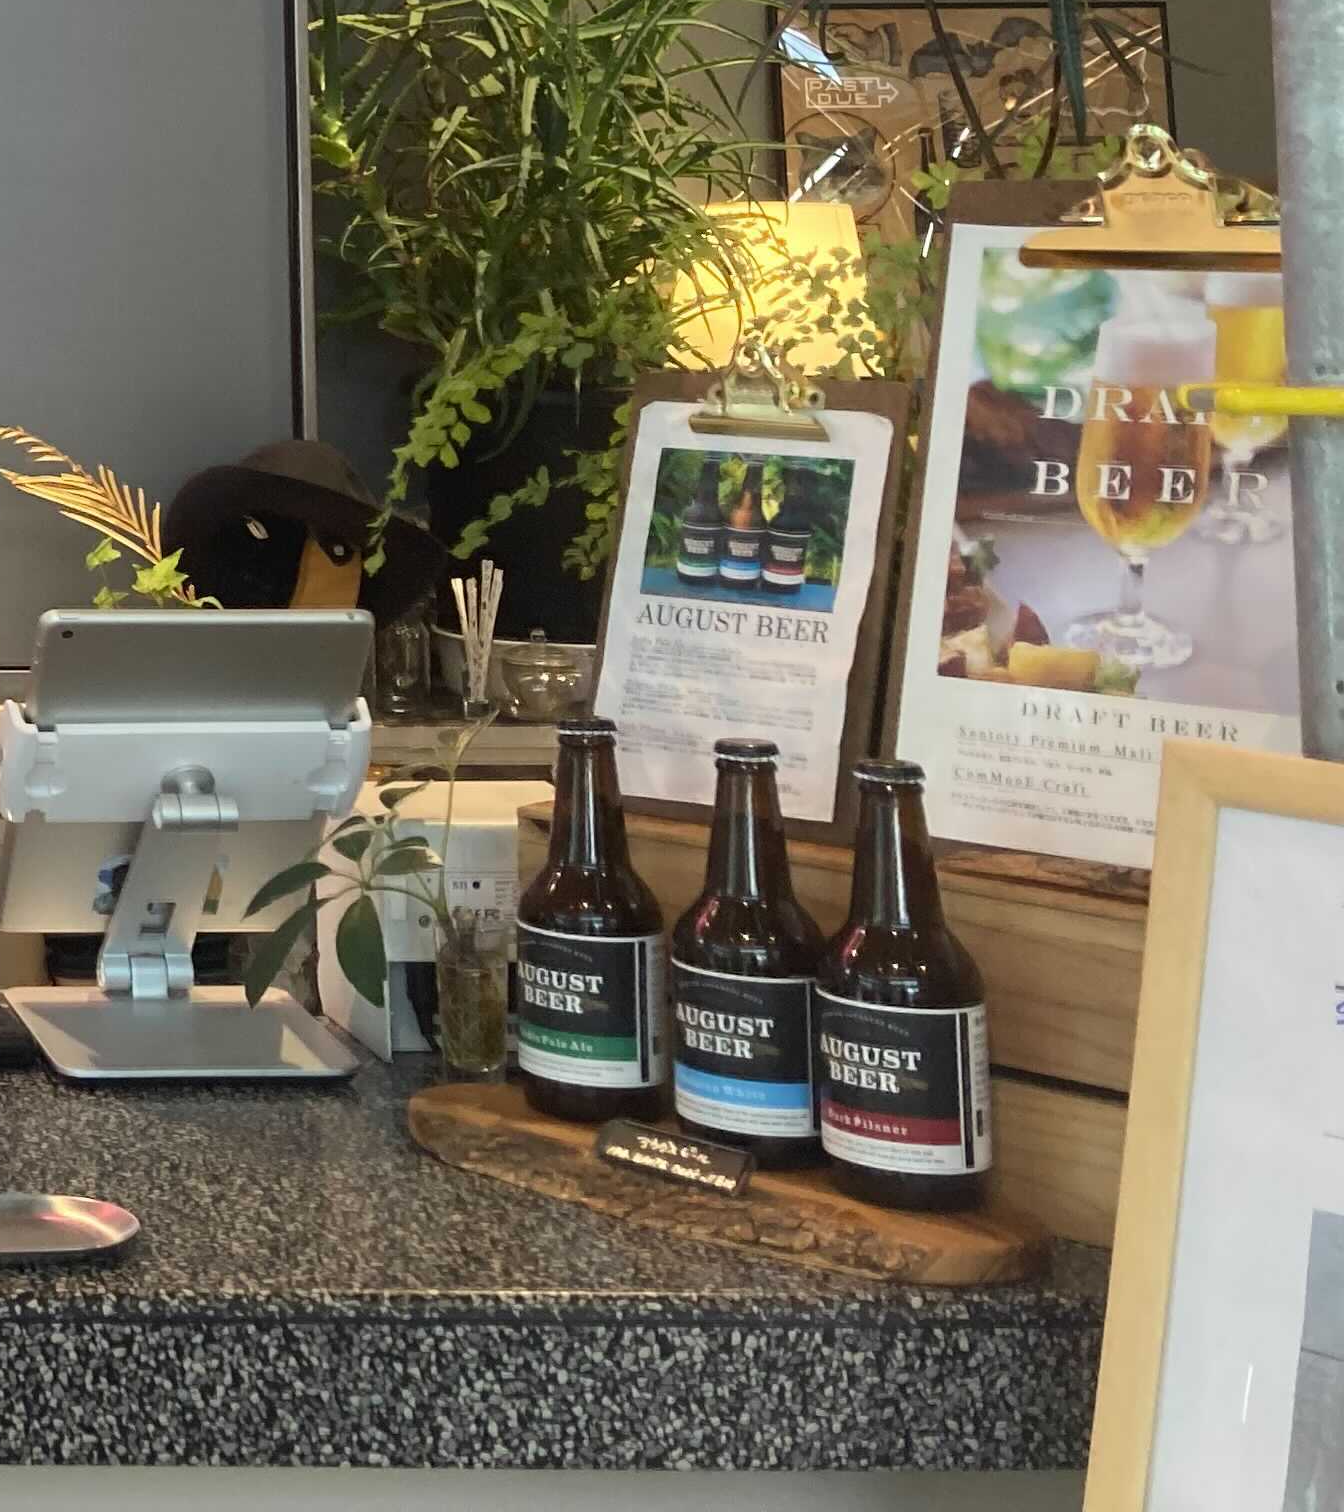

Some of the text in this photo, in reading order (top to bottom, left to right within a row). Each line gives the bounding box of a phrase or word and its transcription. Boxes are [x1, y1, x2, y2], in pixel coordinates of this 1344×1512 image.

[809, 80, 873, 92] PAST
[817, 93, 868, 104] DUE
[1030, 460, 1268, 508] BEER
[635, 602, 829, 645] AUGUST BEER
[1022, 701, 1238, 742] DRAFT BEER
[518, 959, 603, 994] AUGUST
[525, 984, 584, 1014] BEER
[676, 1002, 774, 1038] AUGUST
[685, 1028, 753, 1059] BEER
[821, 1033, 921, 1071] AUGUST
[830, 1060, 900, 1094] BEER
